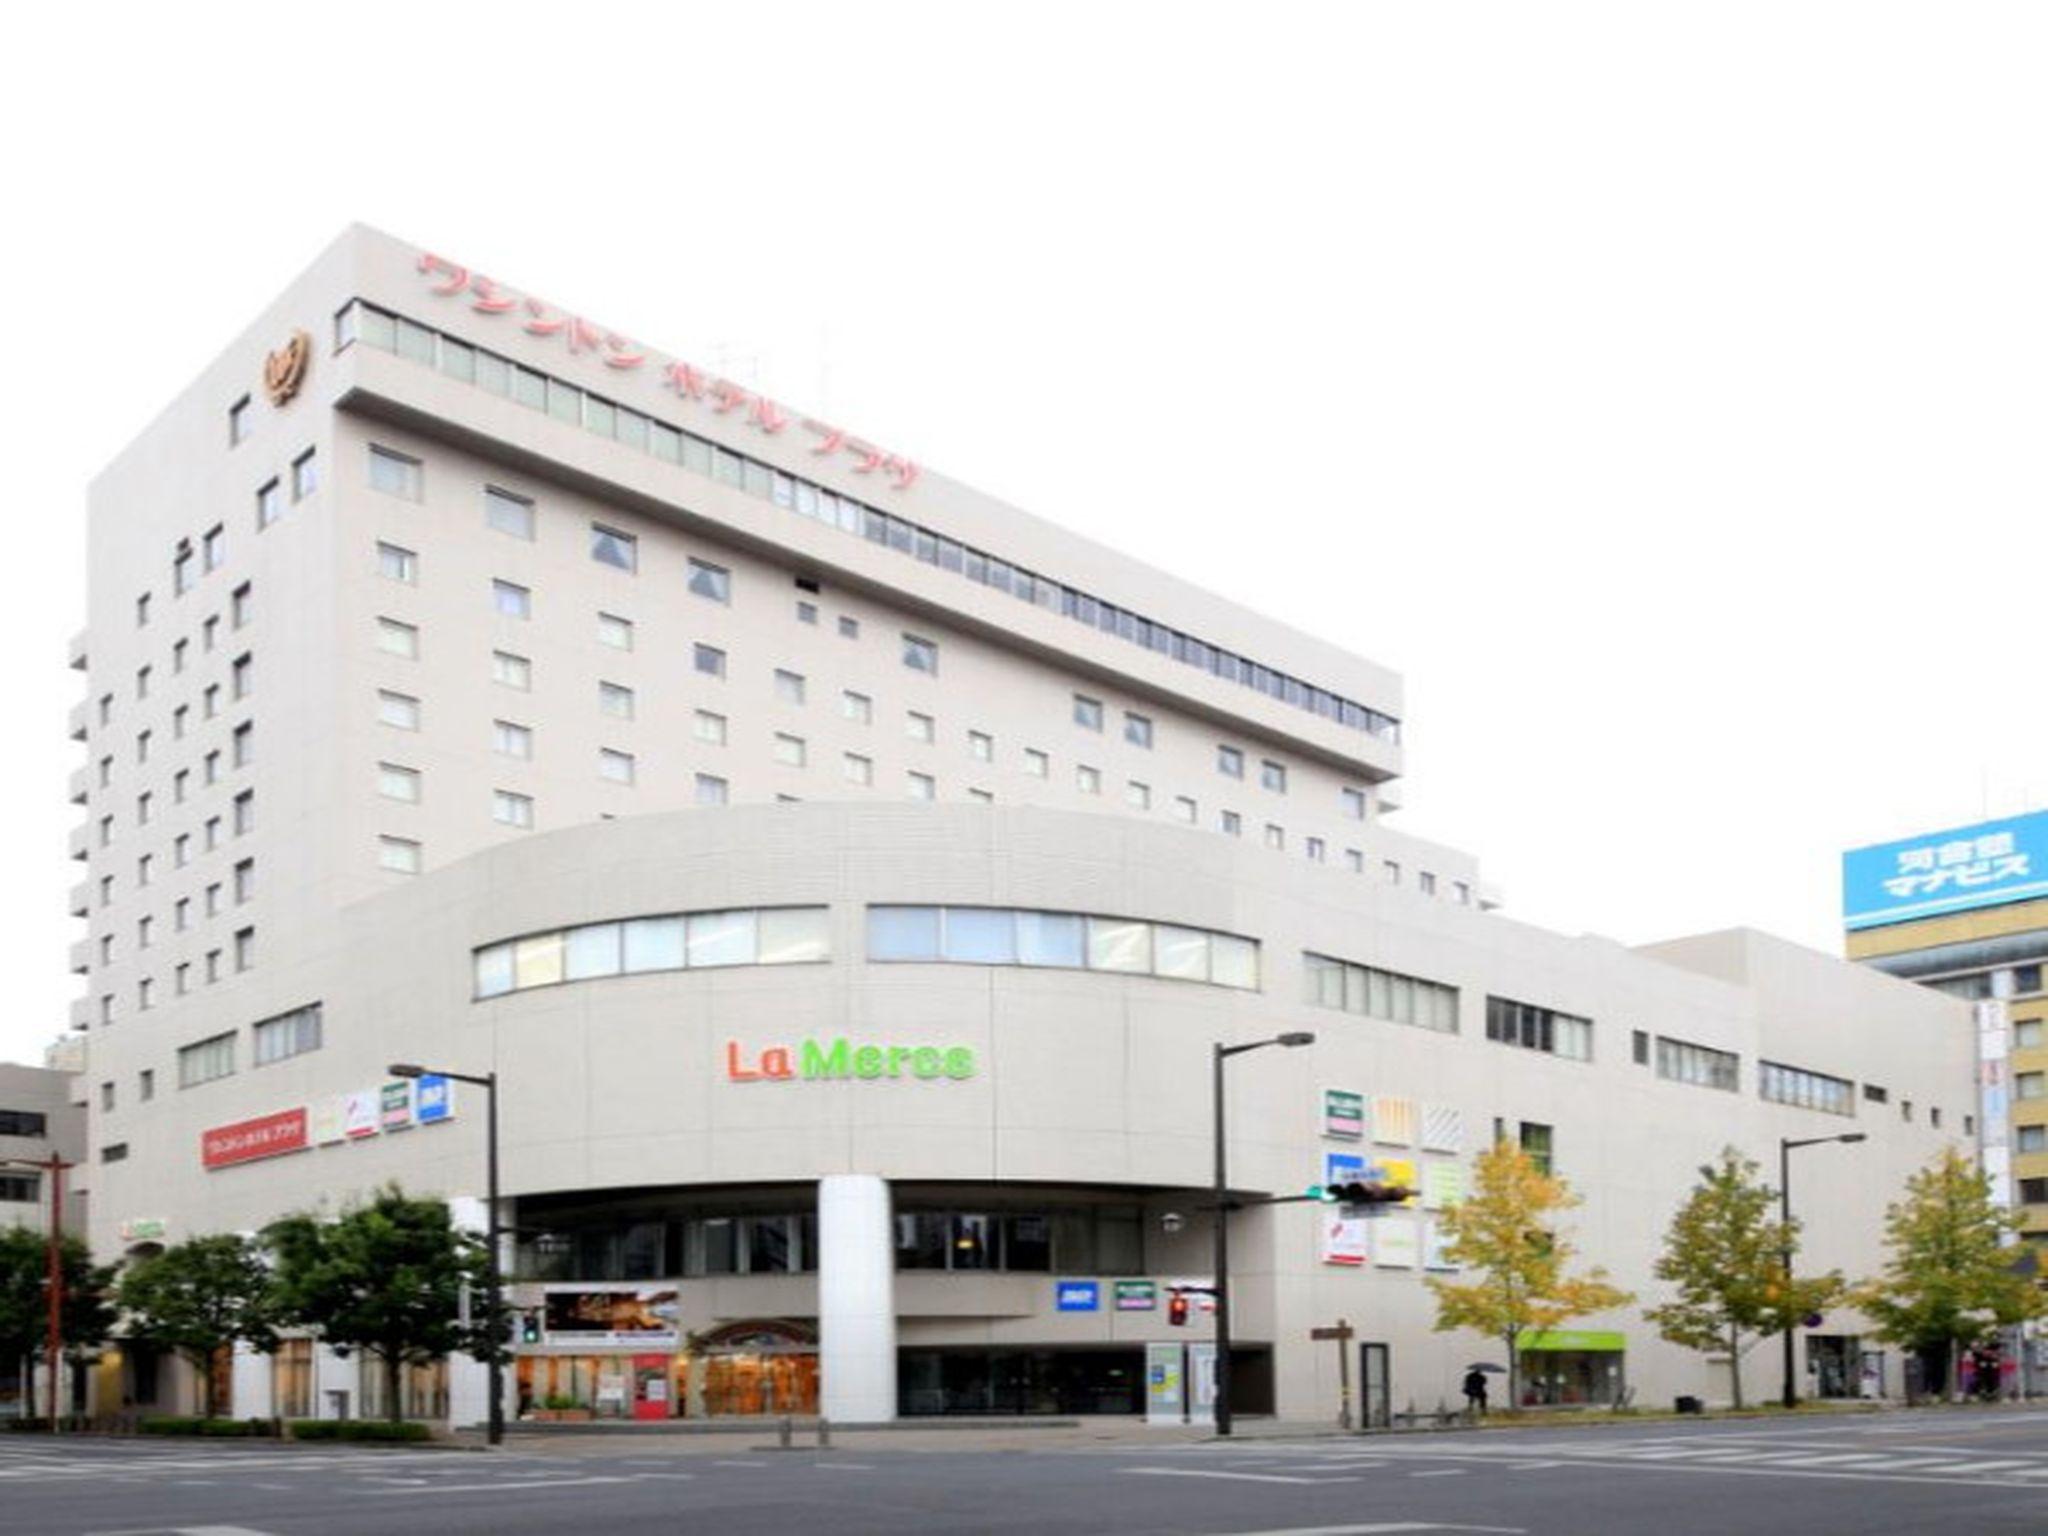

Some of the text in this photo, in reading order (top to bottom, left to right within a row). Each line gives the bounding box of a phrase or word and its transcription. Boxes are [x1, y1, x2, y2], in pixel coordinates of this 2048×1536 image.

[417, 253, 647, 369] ワシントン
